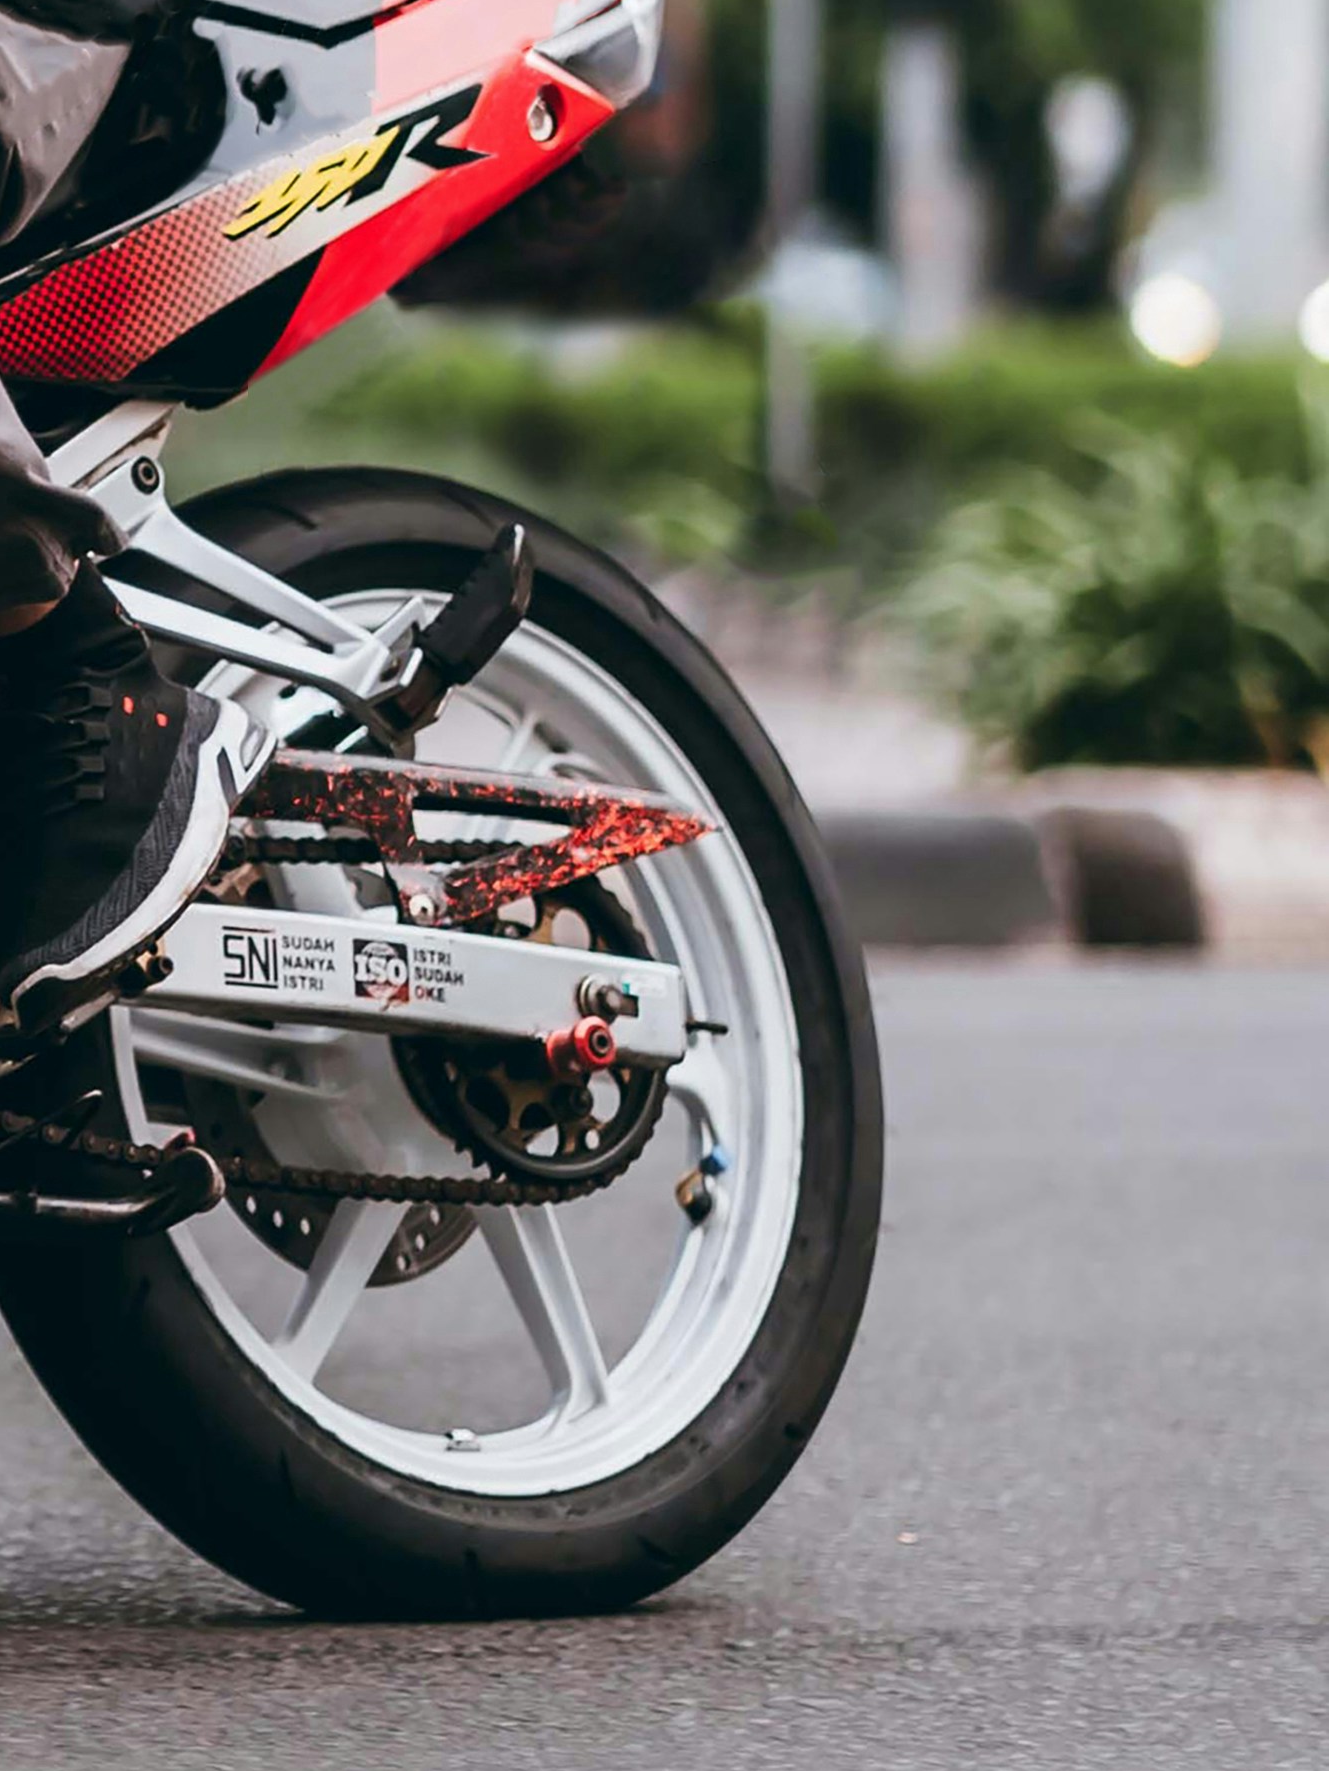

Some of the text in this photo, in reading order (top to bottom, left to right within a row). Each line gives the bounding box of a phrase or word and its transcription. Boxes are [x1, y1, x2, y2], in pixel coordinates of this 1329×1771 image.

[281, 935, 335, 953] SUDAH
[223, 934, 278, 983] SNI
[282, 957, 336, 972] NANYA
[413, 948, 452, 966] ISTRI
[354, 954, 408, 987] ISO
[413, 967, 465, 986] SUDAH
[283, 975, 324, 992] ISTRI
[414, 985, 446, 1003] OKE
